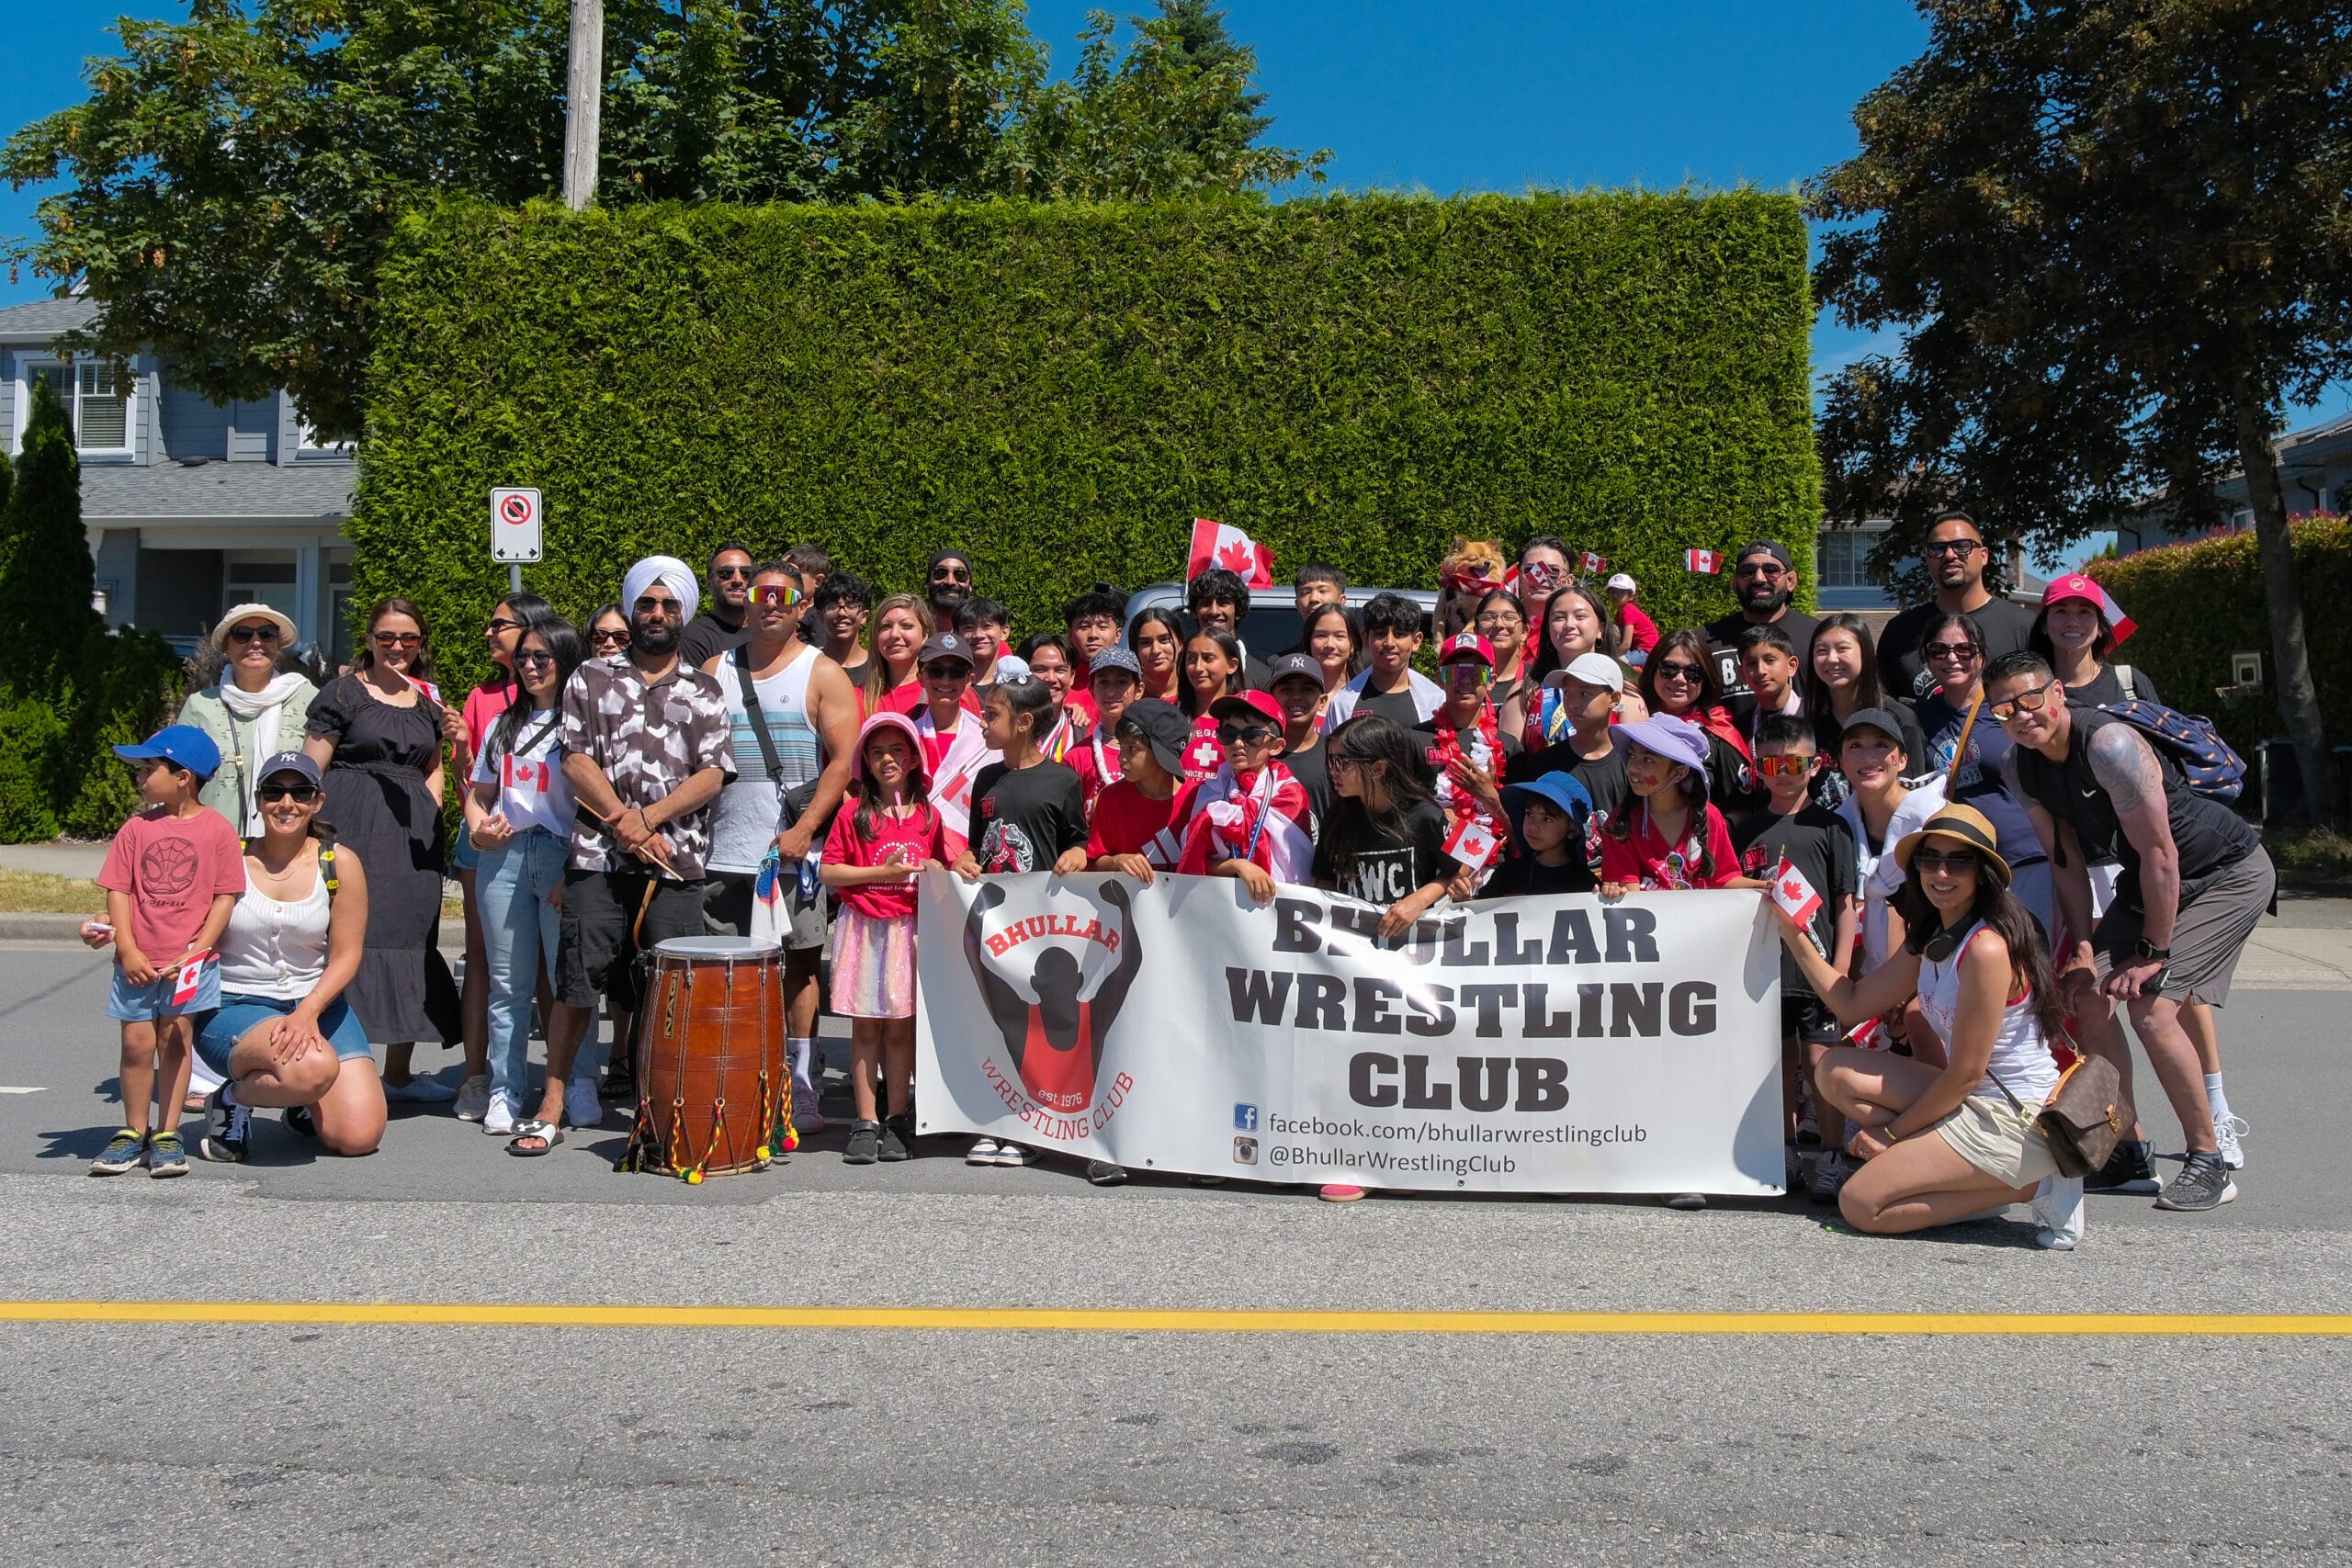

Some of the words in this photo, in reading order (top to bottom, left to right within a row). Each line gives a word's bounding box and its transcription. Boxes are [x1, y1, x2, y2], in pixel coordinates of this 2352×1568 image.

[984, 914, 1122, 957] BHULLAR
[1272, 897, 1660, 967] BHULLAR
[1226, 966, 1717, 1039] WRESTLING
[980, 1056, 1090, 1140] WRESTLING
[1092, 1071, 1134, 1130] CLUB
[1061, 1092, 1082, 1107] 1976
[1349, 1051, 1570, 1112] CLUB
[1269, 1112, 1647, 1145] facebook.com/bhullarwrestlingclub
[1269, 1145, 1516, 1176] @BhullarWrestlingClub
